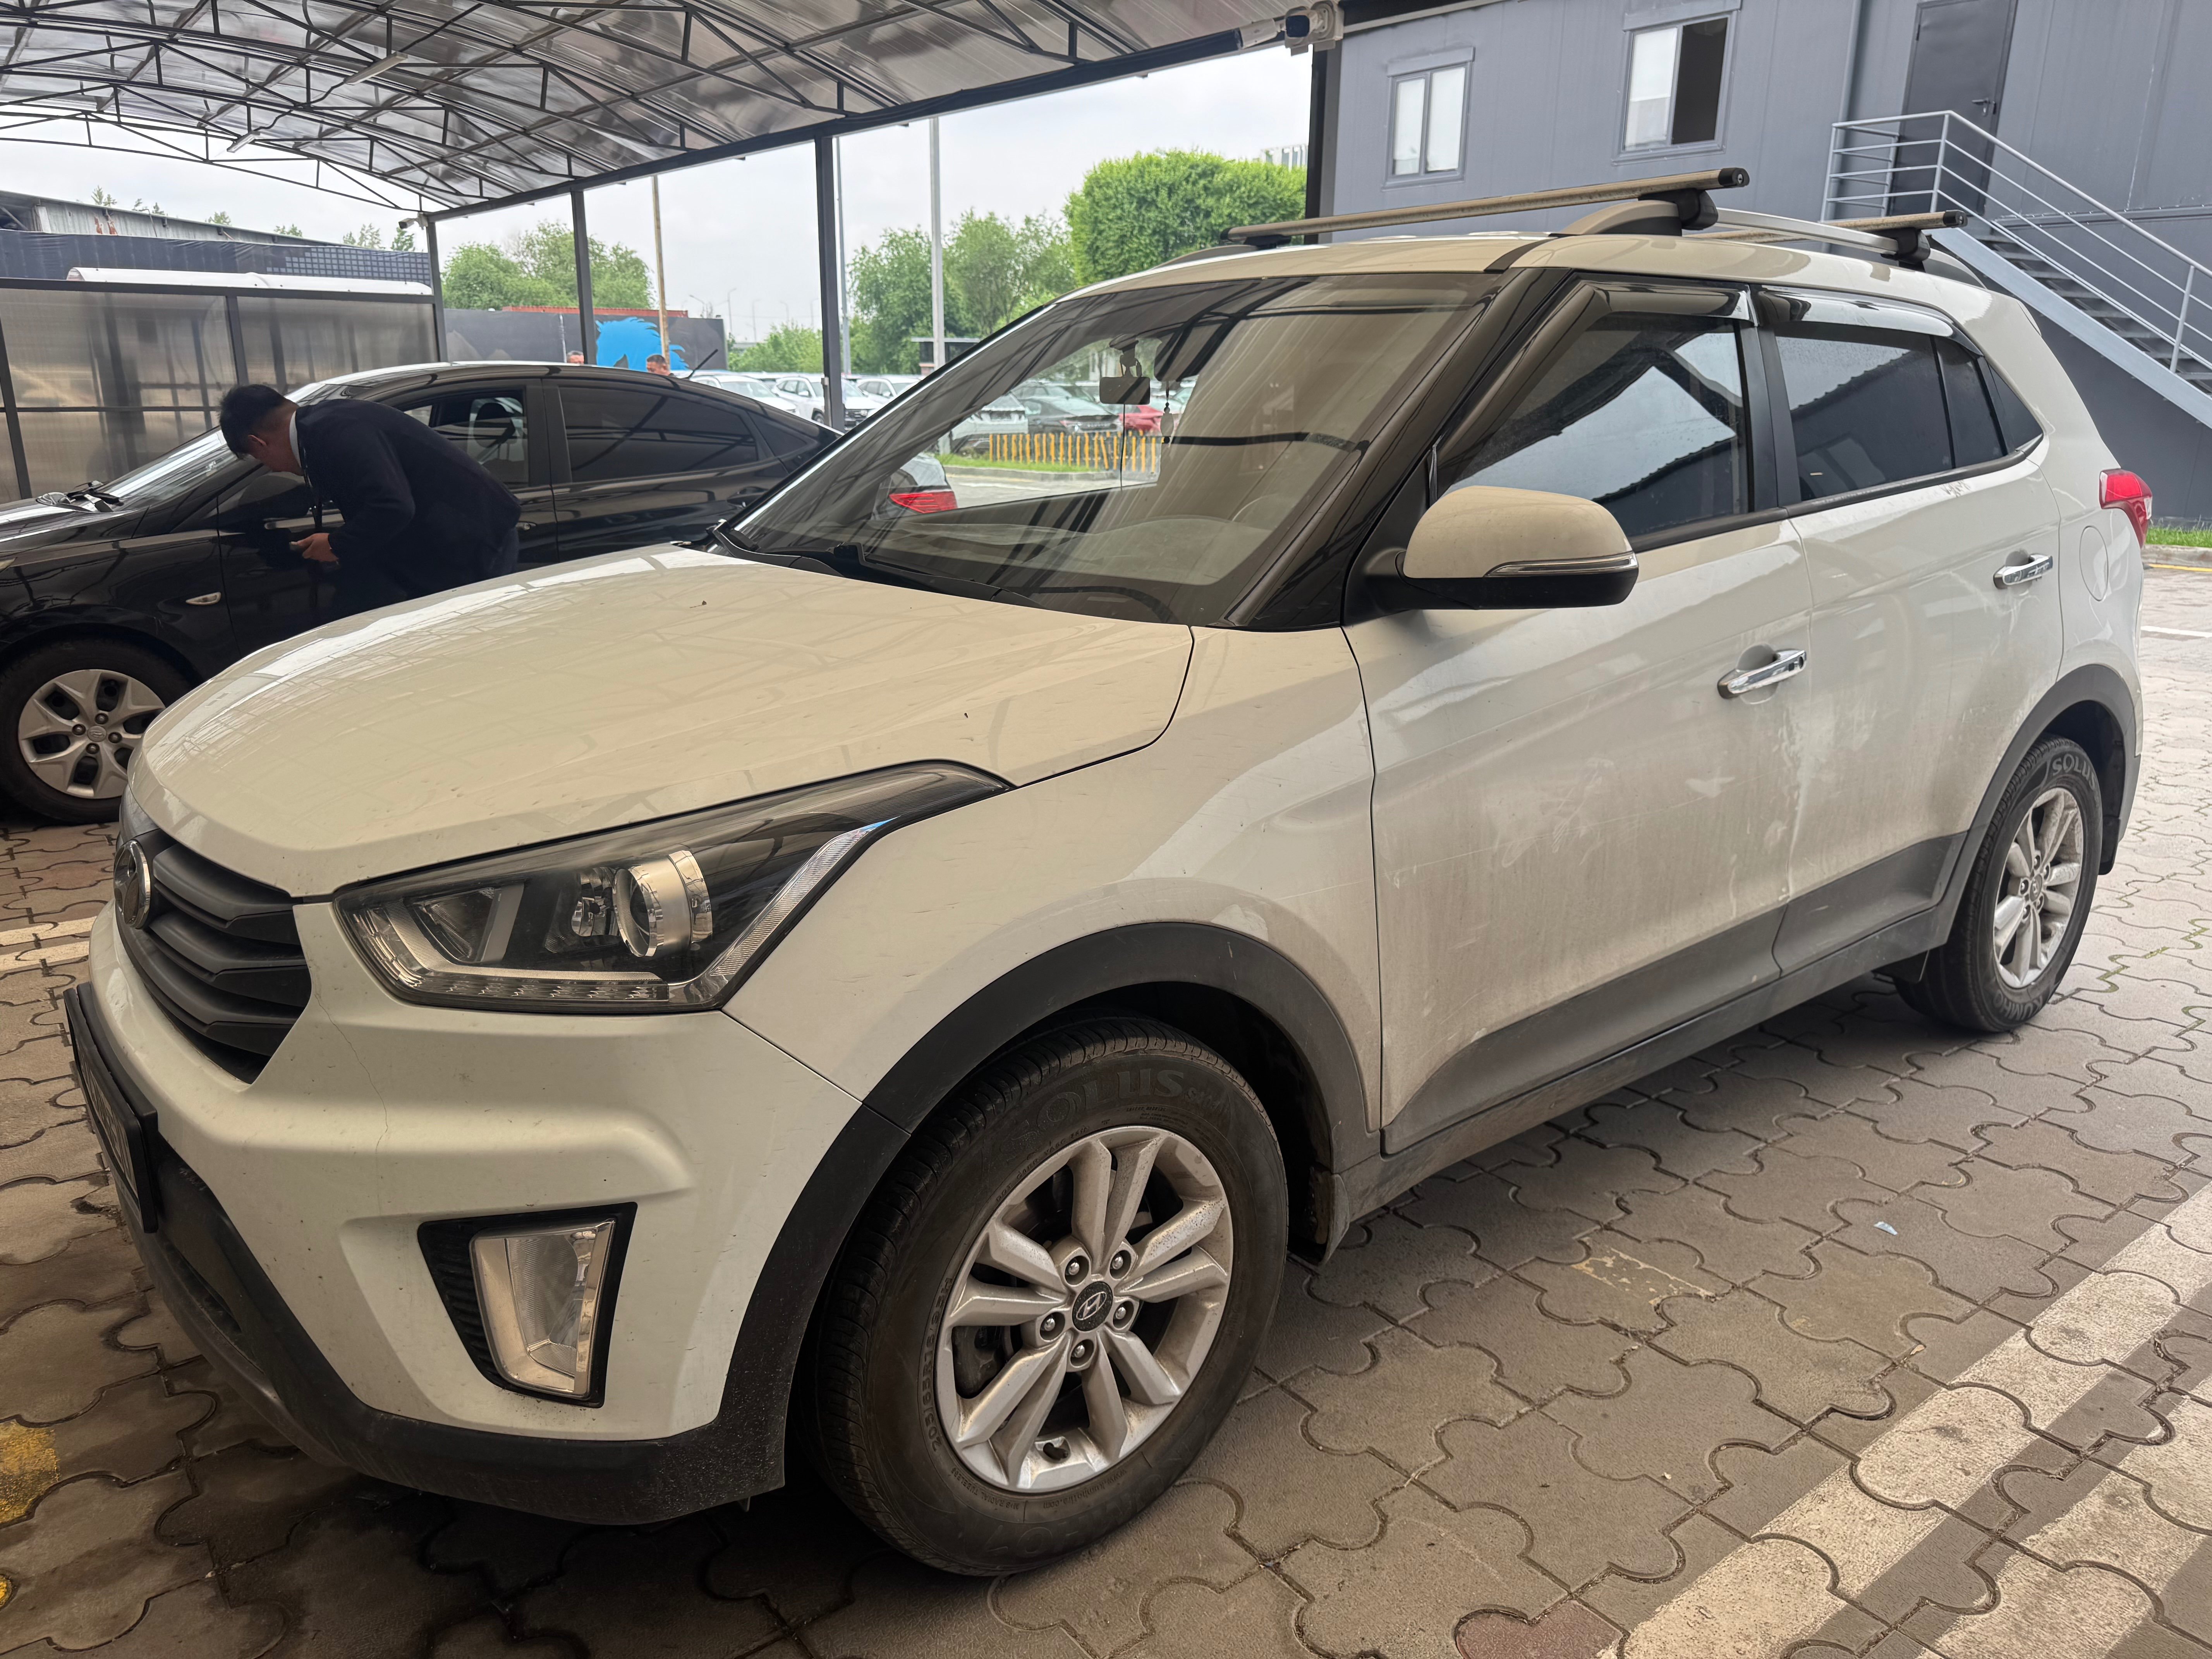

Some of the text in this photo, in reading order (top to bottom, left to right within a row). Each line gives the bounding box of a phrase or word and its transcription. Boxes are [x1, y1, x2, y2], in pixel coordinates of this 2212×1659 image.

[2052, 753, 2096, 791] SOLUS
[1993, 990, 2043, 1020] KUMHO
[998, 1067, 1185, 1165] SOLUS
